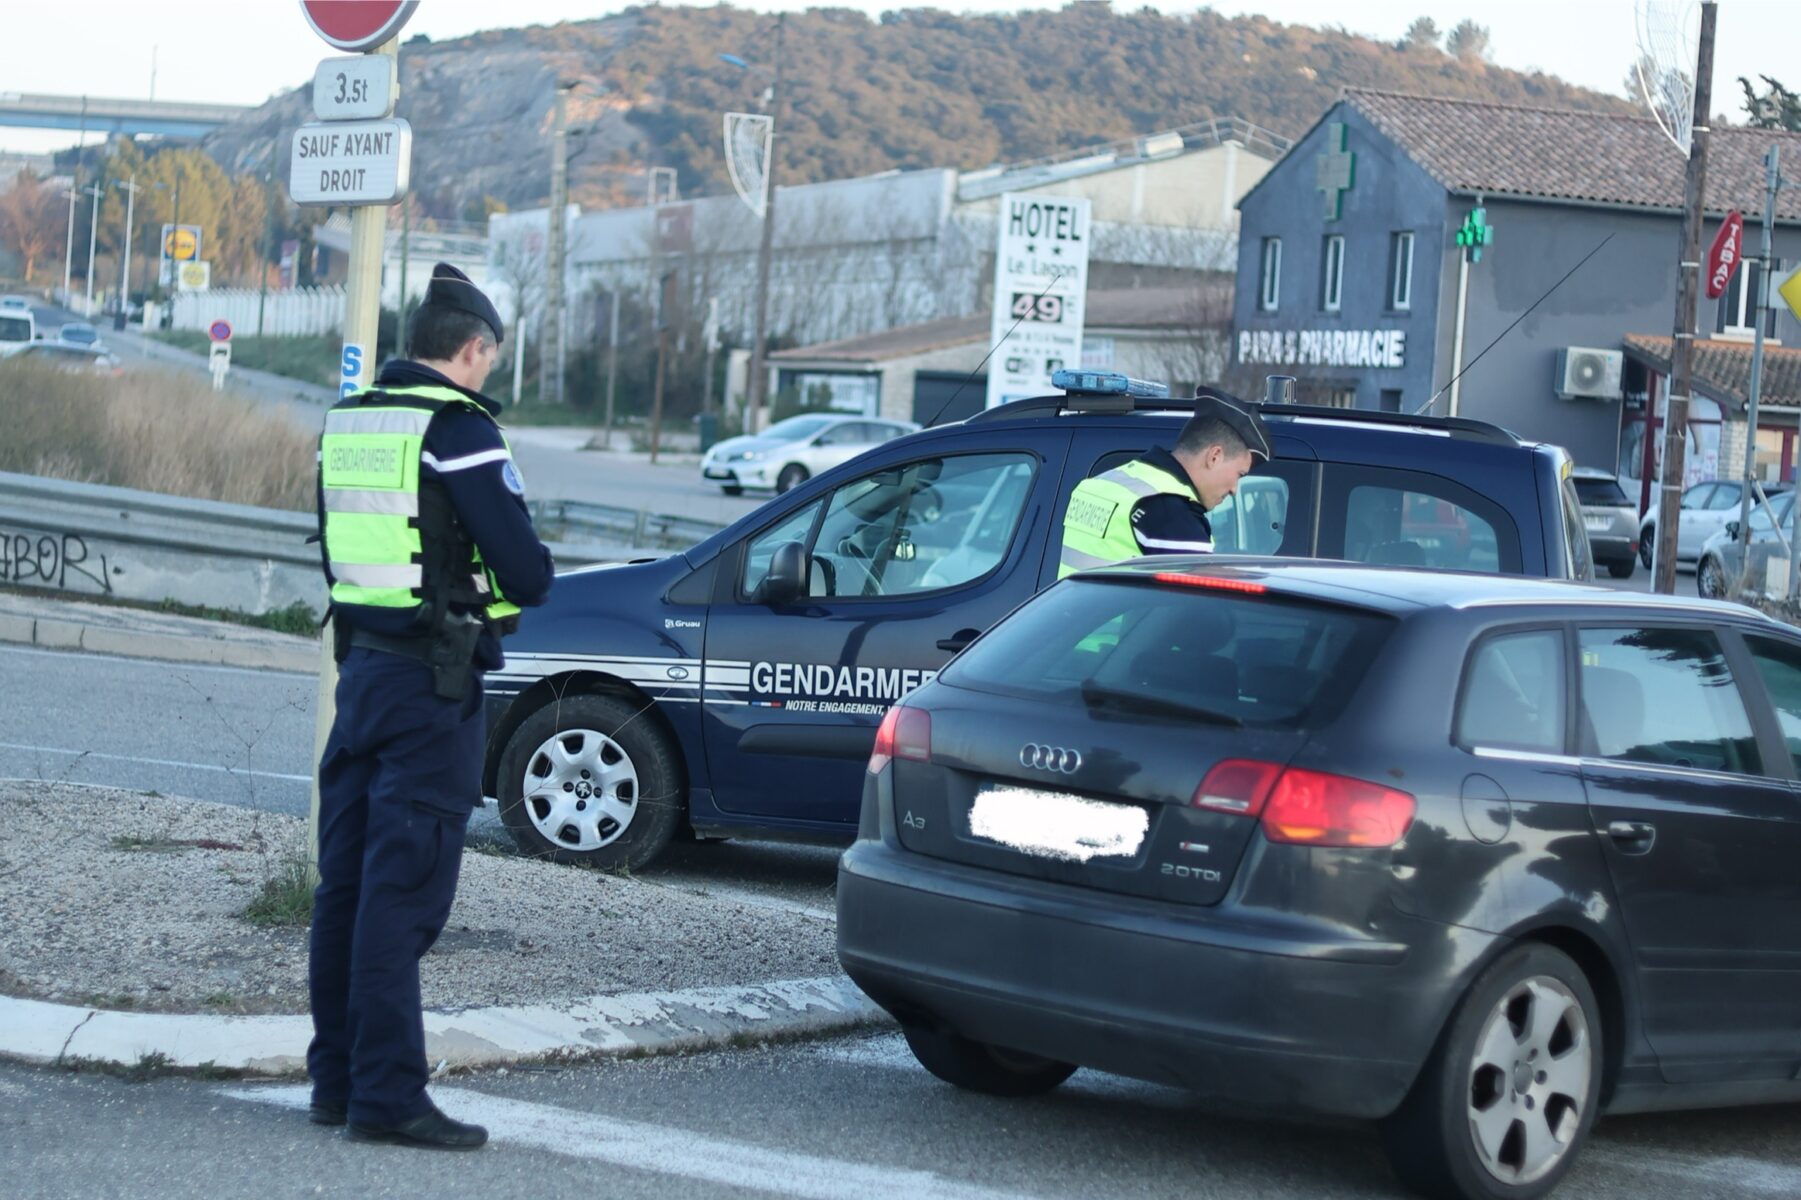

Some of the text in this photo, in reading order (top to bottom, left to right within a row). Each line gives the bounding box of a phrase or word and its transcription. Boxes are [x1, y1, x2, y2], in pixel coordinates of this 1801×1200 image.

[334, 72, 368, 104] 3.5t
[299, 132, 392, 158] SAUF AYANT
[320, 169, 366, 192] DROIT
[1008, 201, 1081, 241] HOTEL
[1008, 256, 1024, 274] Le
[1712, 223, 1739, 289] TABAC
[1012, 293, 1062, 322] 49
[1298, 329, 1405, 367] PHARMACIE
[330, 447, 397, 473] GENDARMERIE
[675, 620, 700, 628] Gruau
[785, 700, 817, 712] NOTRE
[818, 702, 884, 716] ENGAGEMENT,
[903, 810, 926, 829] A3
